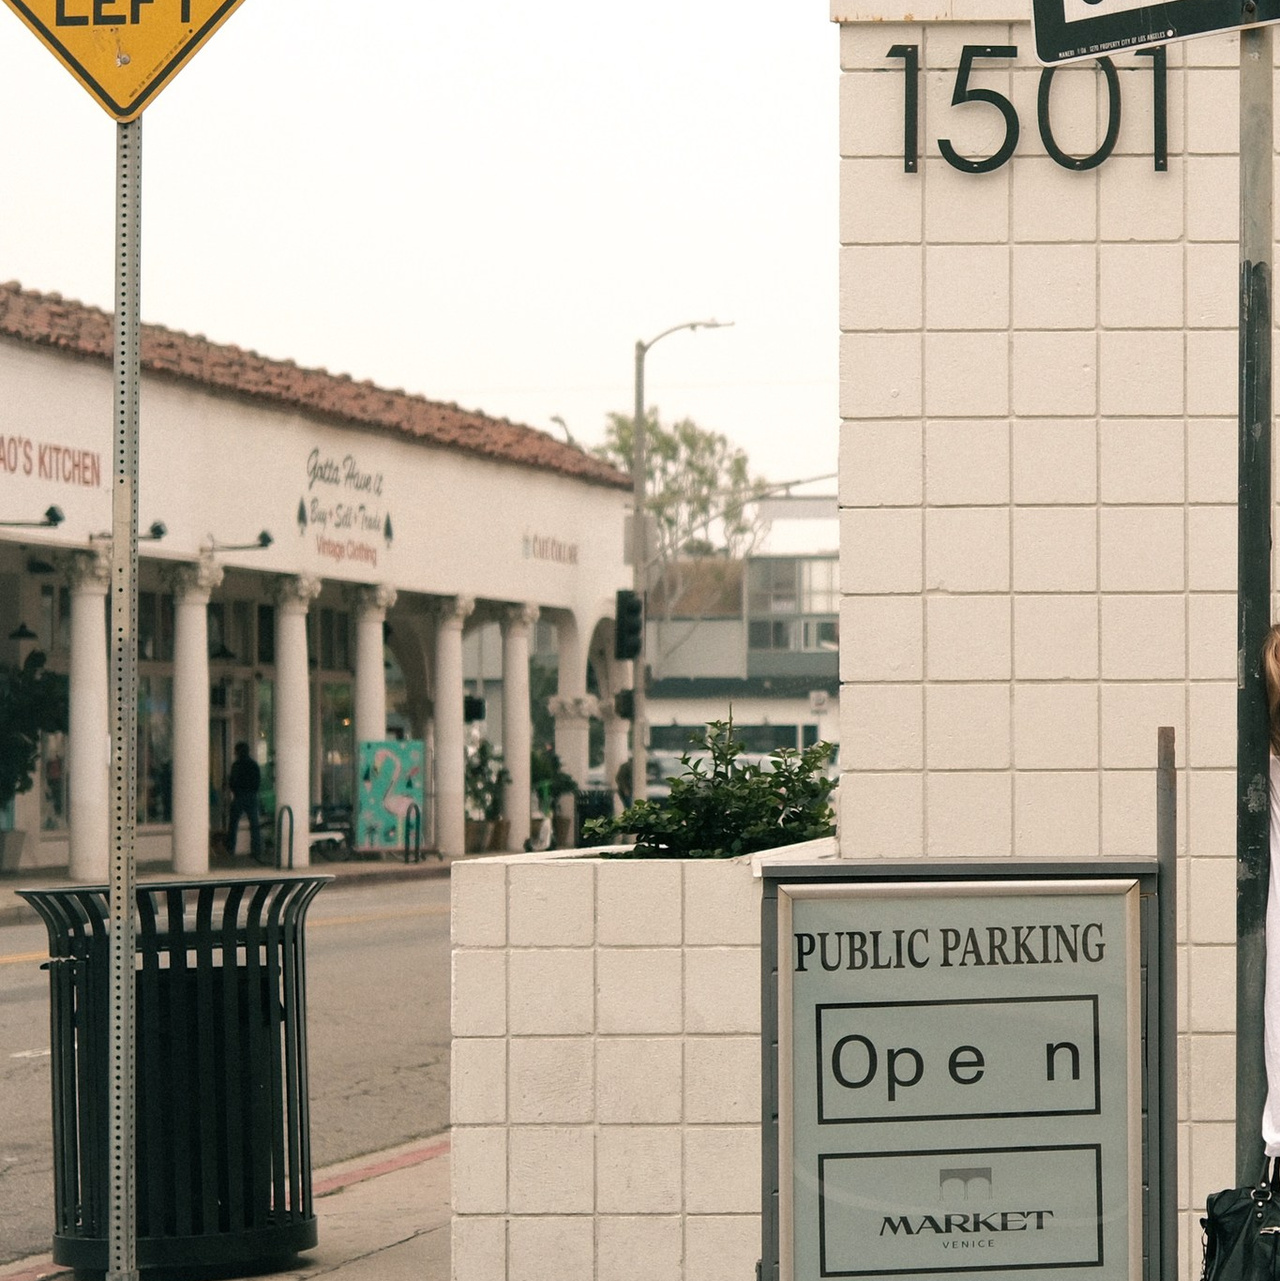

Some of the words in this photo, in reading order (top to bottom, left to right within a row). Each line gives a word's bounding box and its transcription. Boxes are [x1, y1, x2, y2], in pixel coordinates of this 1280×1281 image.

[1099, 40, 1120, 52] PROPERTY
[1120, 38, 1131, 47] CITY
[1131, 36, 1137, 44] OF
[1137, 34, 1147, 43] LOS
[1146, 31, 1166, 41] ANGELES
[885, 44, 1169, 175] 1501
[38, 442, 100, 487] KITCHEN
[315, 534, 345, 562] Vintage
[346, 539, 377, 569] Clothing
[794, 928, 931, 972] PUBLIC
[939, 922, 1107, 967] PARKING
[879, 1210, 1055, 1236] MARKET
[942, 1239, 996, 1249] VENICE
